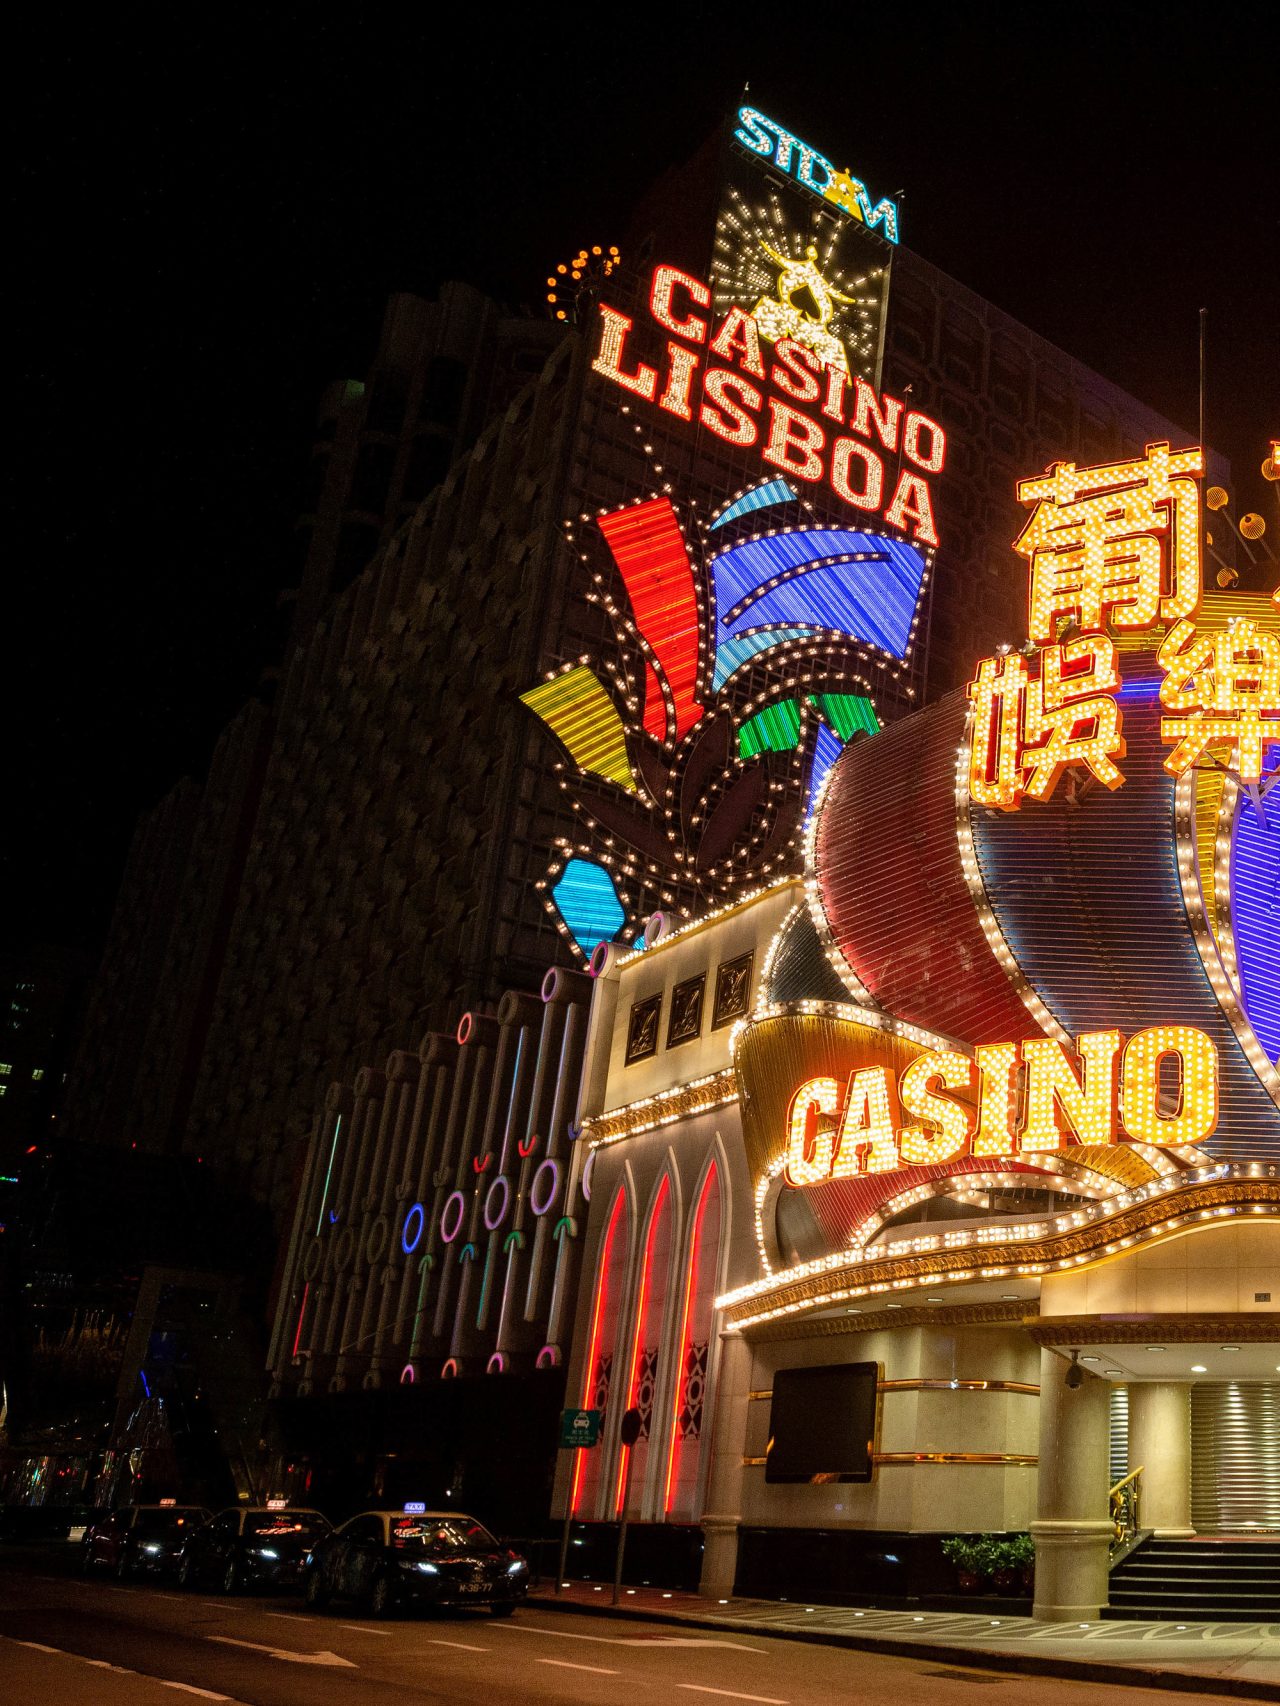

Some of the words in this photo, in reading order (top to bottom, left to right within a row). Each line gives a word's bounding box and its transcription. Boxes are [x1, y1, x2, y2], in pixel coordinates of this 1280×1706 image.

[592, 303, 940, 548] LISBOA
[649, 263, 947, 474] CASINO
[785, 1025, 1219, 1187] CASINO
